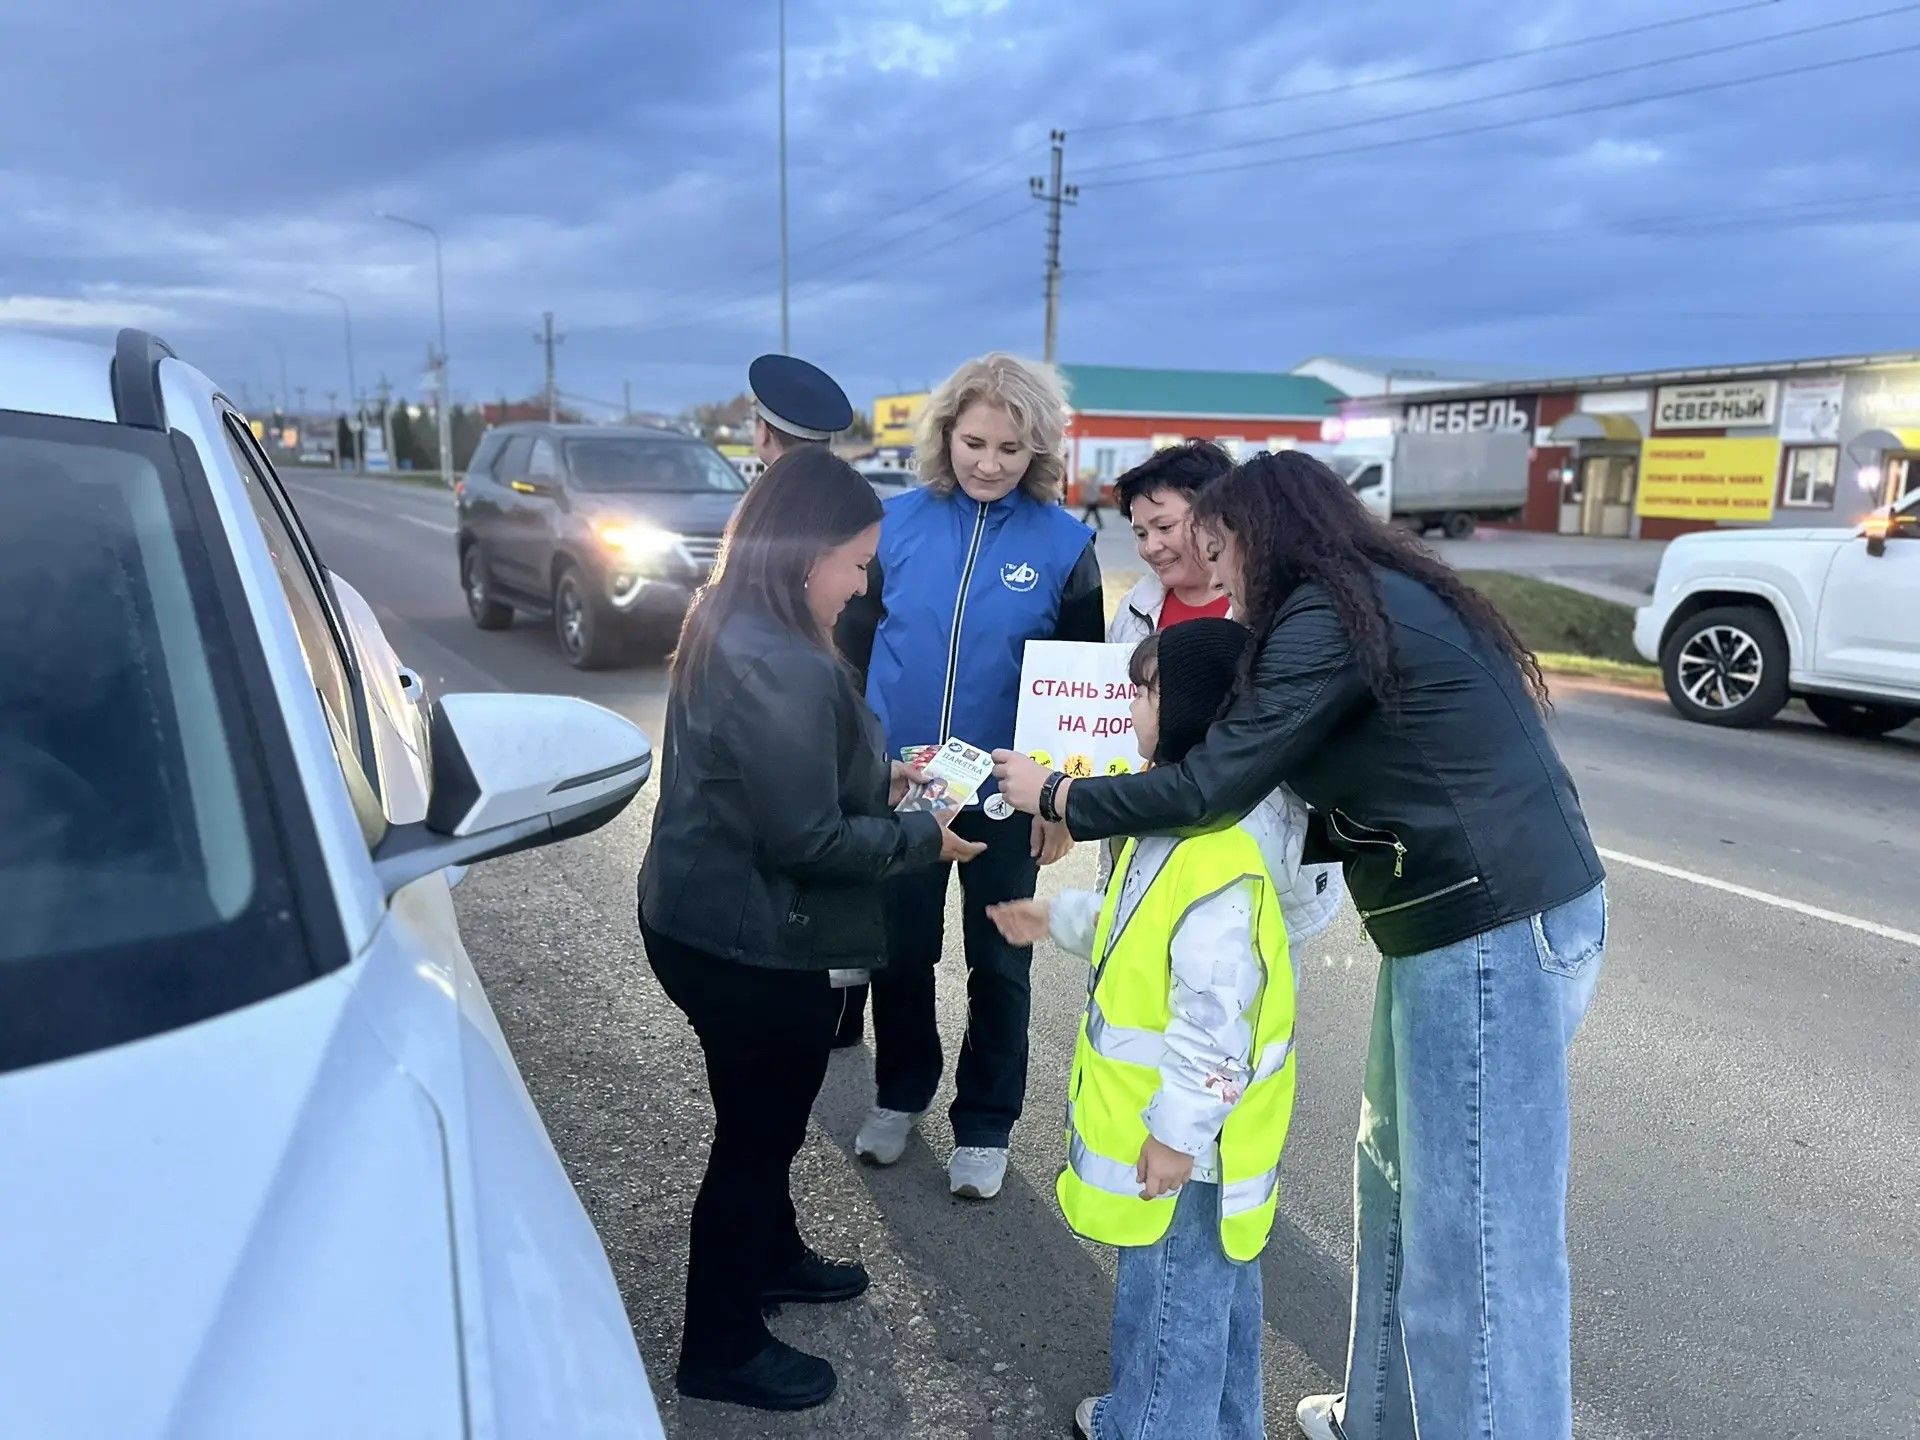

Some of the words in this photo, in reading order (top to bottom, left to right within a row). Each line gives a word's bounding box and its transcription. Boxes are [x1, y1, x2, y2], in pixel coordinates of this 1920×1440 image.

[1407, 398, 1529, 433] МЕБЕЛЬ
[1662, 394, 1765, 422] СЕВЕРНЫЙ
[1032, 680, 1099, 698] СТАНЬ
[1104, 683, 1137, 699] ЗАМ
[1058, 715, 1087, 732] НА
[1092, 717, 1133, 737] ДОР
